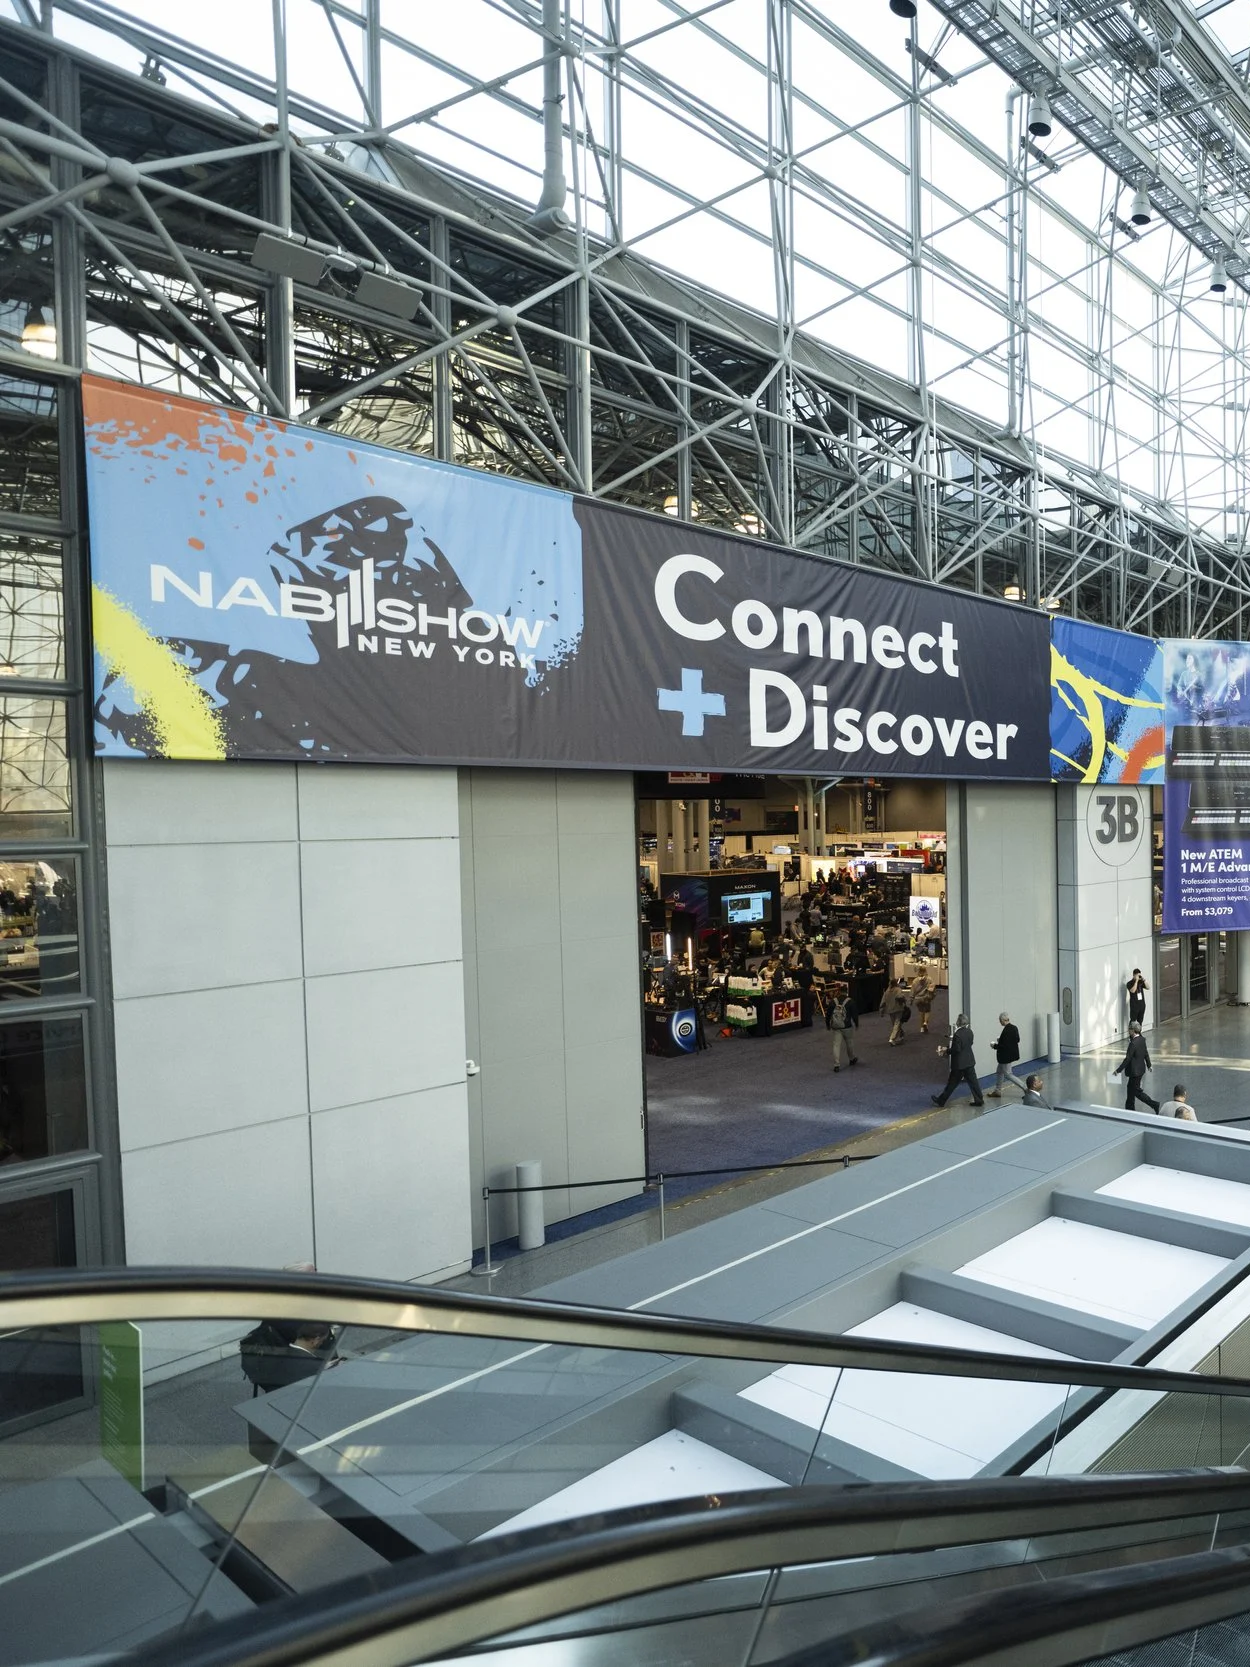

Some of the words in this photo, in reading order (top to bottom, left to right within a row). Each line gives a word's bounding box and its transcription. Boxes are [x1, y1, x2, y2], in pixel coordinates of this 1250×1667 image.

[376, 597, 546, 650] SHOW
[654, 553, 960, 678] Connect
[357, 633, 437, 660] NEW
[454, 644, 538, 670] YORK
[749, 667, 1019, 760] Discover
[1095, 795, 1139, 845] 3B
[1180, 849, 1206, 860] New
[1208, 848, 1243, 860] ATEM
[1181, 863, 1187, 874] 1
[1190, 862, 1215, 874] M/E
[1181, 876, 1218, 885] Professional
[1218, 876, 1249, 884] broadcast
[1181, 886, 1195, 894] with
[1195, 886, 1216, 895] system
[1216, 885, 1237, 893] control
[1187, 895, 1226, 903] downstream
[1226, 894, 1249, 903] keyers,
[1181, 908, 1203, 917] From
[1204, 907, 1234, 917] $3,079
[775, 1000, 800, 1020] B&H
